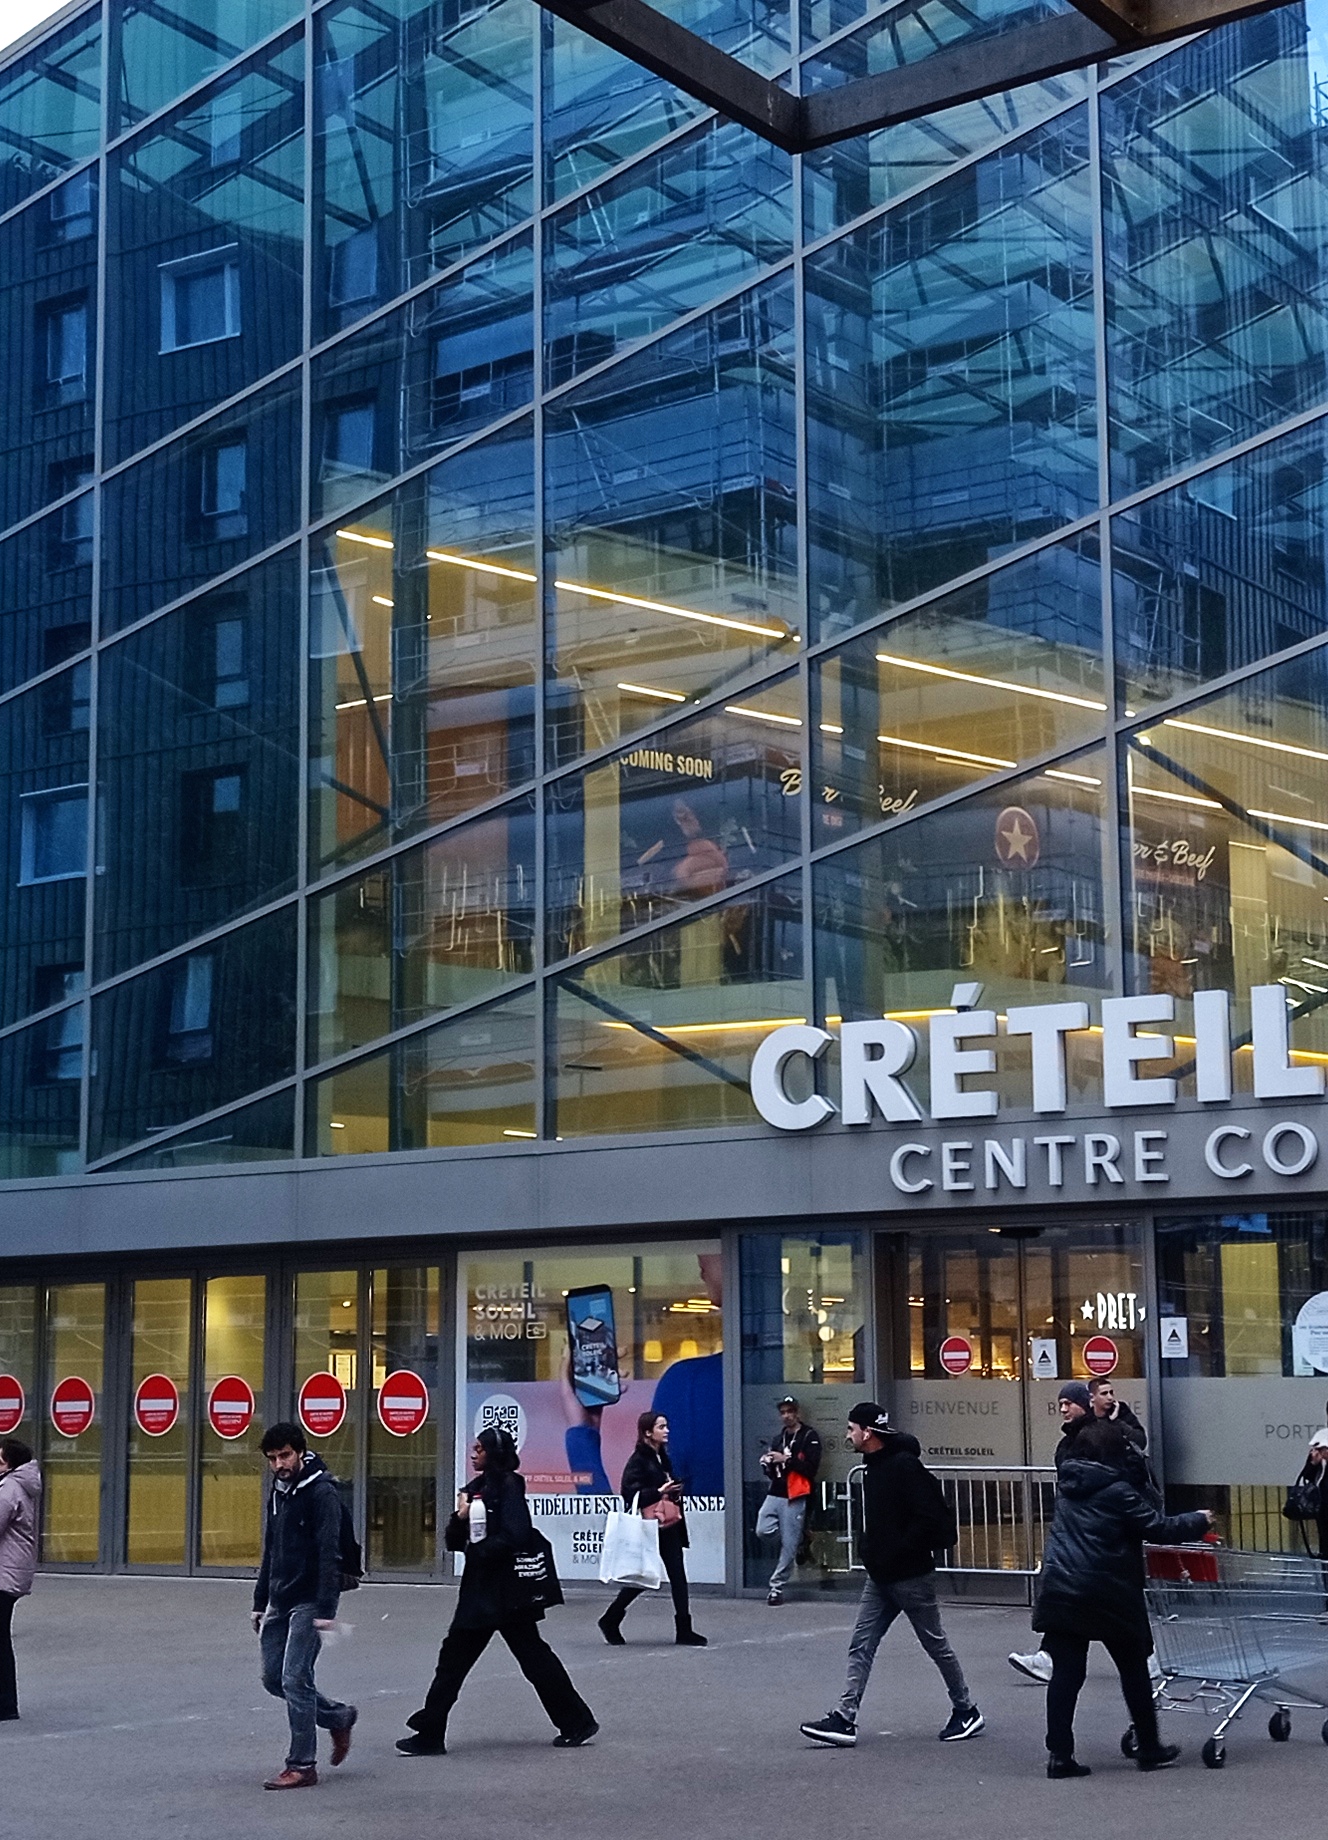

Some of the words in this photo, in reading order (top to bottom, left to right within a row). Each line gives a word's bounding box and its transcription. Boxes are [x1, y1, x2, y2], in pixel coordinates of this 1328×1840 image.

[676, 756, 713, 779] SOON
[1154, 840, 1169, 866] &
[1171, 840, 1216, 881] Beef
[750, 982, 1326, 1131] CRÉTEIL
[889, 1130, 1170, 1193] CENTRE
[475, 1302, 537, 1321] SOLEIL
[1096, 1292, 1137, 1331] PRET
[473, 1323, 485, 1341] &
[489, 1321, 522, 1341] MOI
[909, 1400, 1000, 1416] BIENVENUE
[928, 1446, 962, 1456] CRÉTEIL
[964, 1448, 995, 1456] SOLEIL
[594, 1496, 620, 1515] EST
[573, 1554, 581, 1564] &
